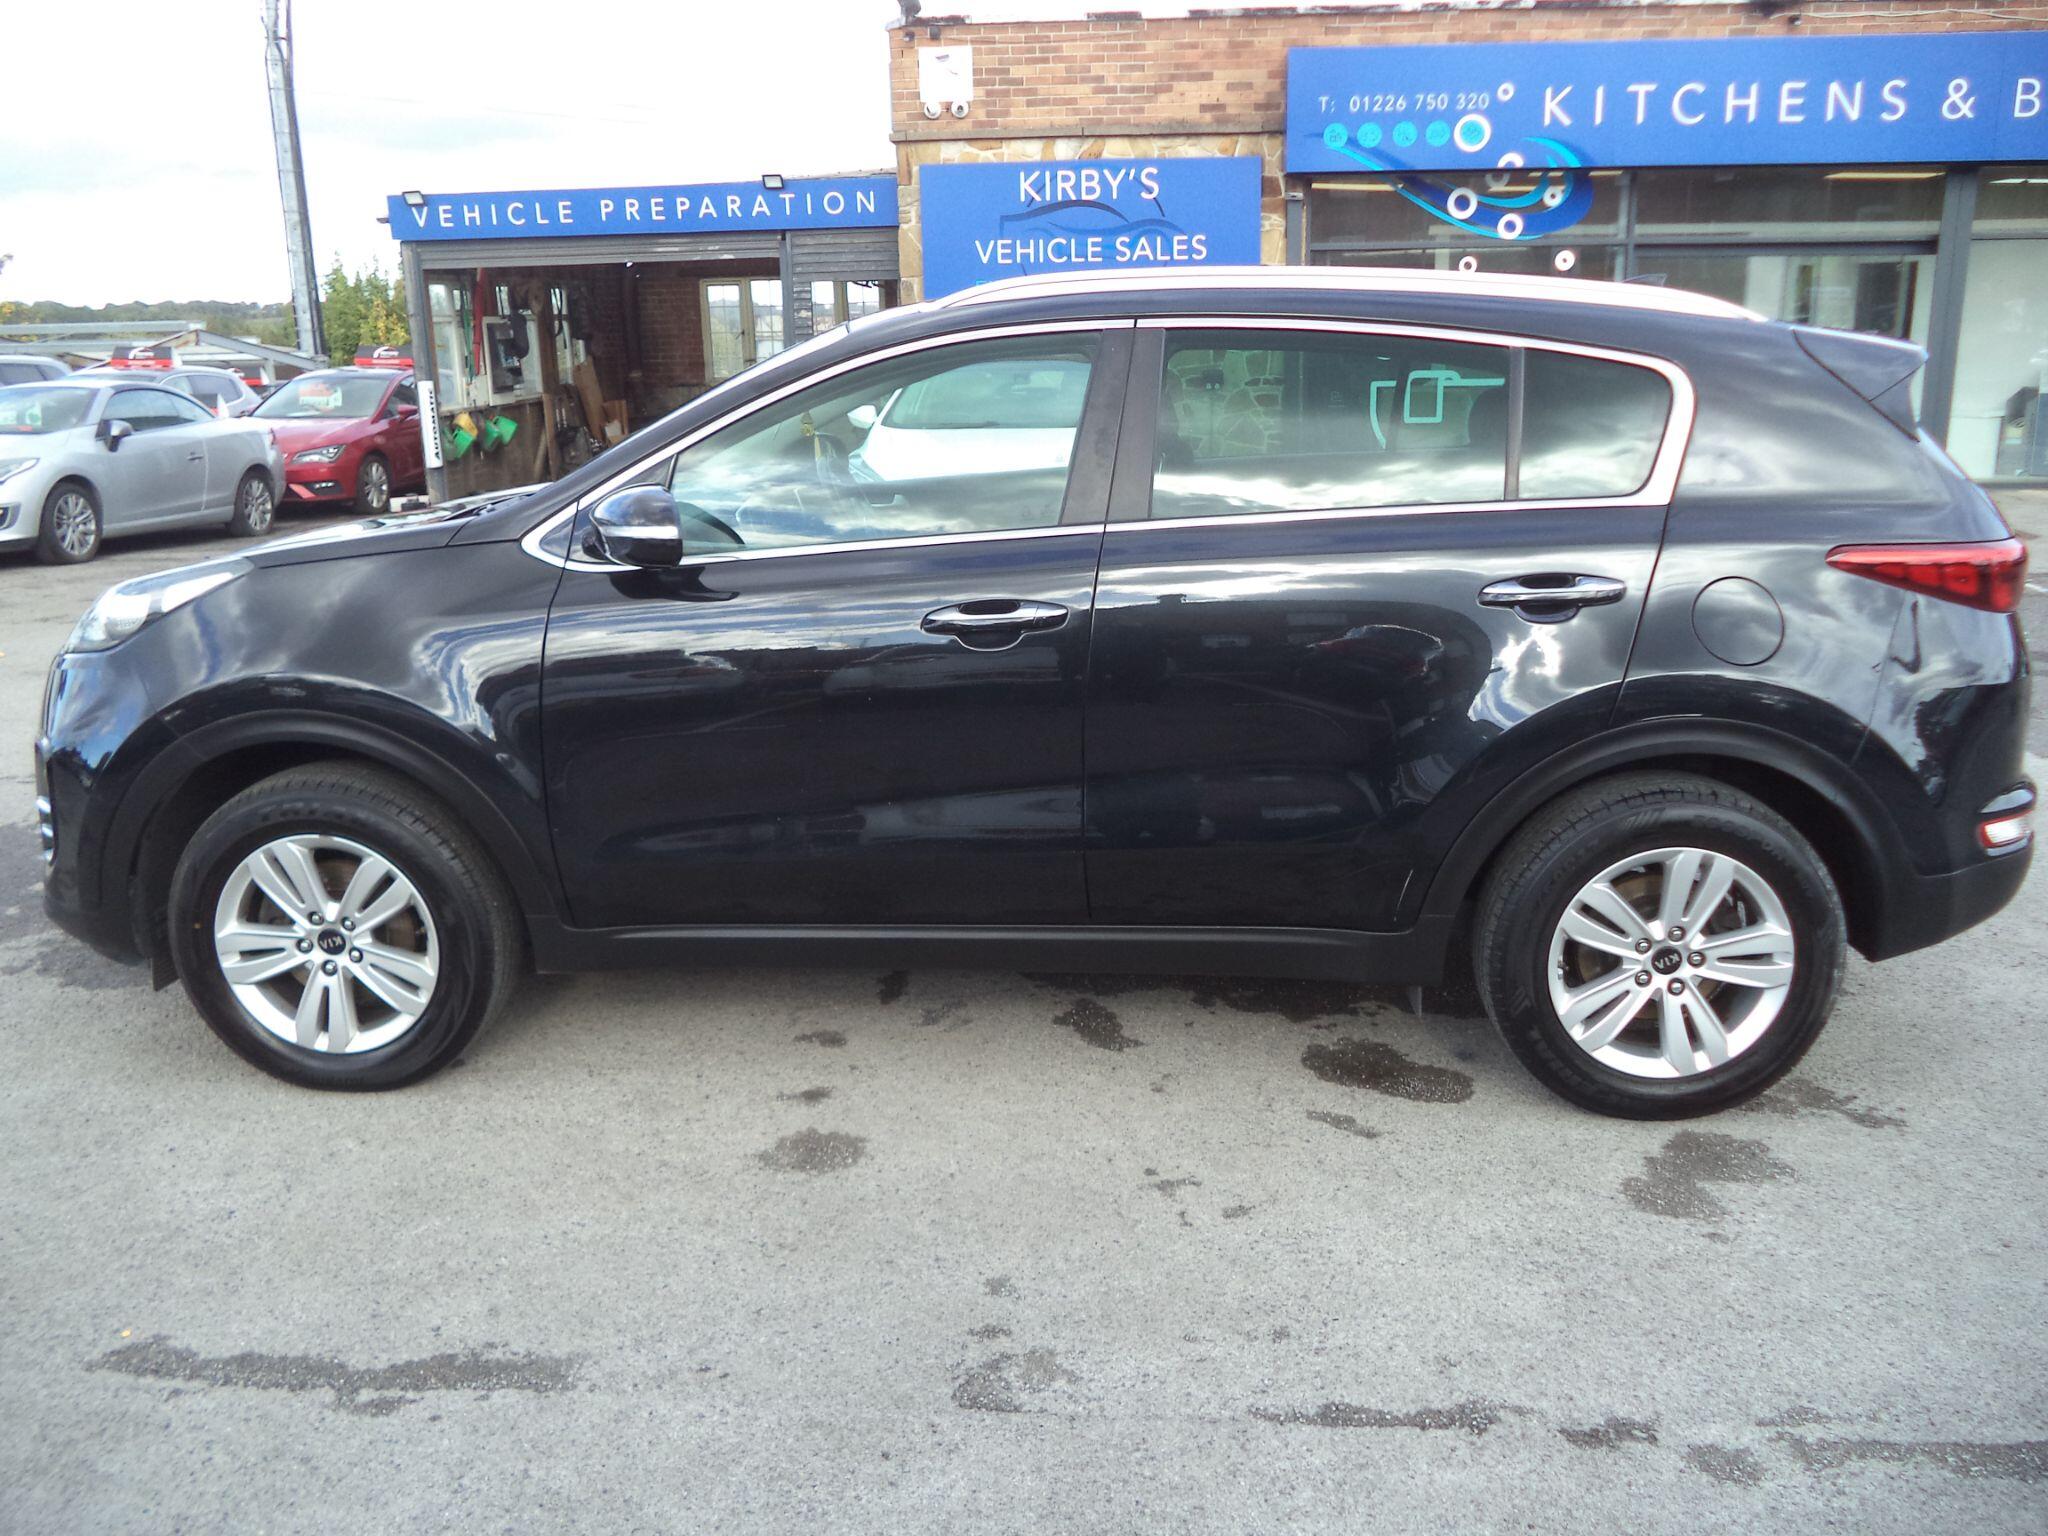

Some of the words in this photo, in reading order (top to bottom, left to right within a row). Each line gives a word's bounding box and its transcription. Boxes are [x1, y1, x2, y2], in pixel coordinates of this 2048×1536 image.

[1349, 94, 1407, 113] 01226
[1416, 93, 1449, 111] 750
[1456, 92, 1490, 111] 320
[1543, 80, 1907, 127] KITCHENS
[1941, 78, 1976, 120] &
[2013, 77, 2042, 118] B
[1019, 167, 1160, 202] KIRBY'S
[411, 203, 574, 228] VEHICLE
[601, 191, 875, 222] PREPARATION
[974, 237, 1103, 264] VEHICLE
[1115, 235, 1208, 262] SALES
[428, 387, 441, 460] AUTOMATIC
[319, 935, 343, 950] KIA
[1654, 952, 1681, 970] KIA
